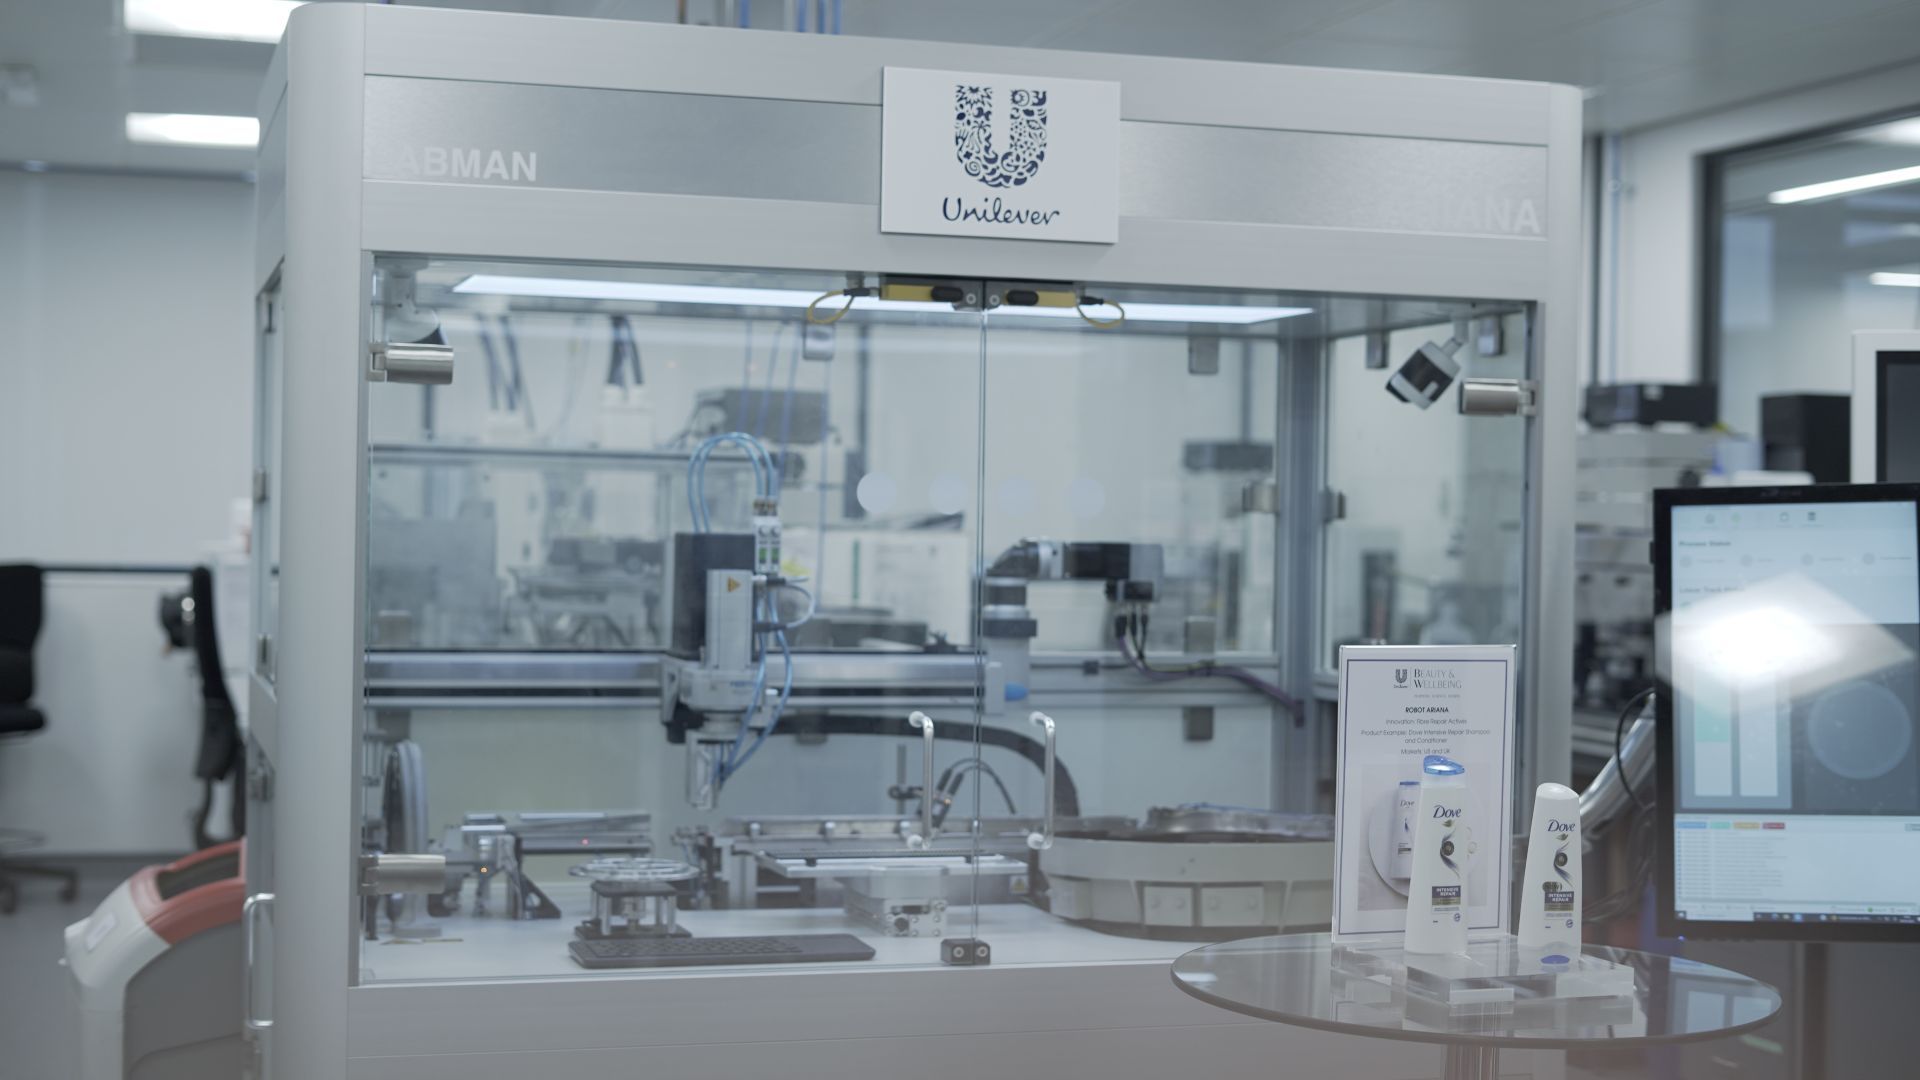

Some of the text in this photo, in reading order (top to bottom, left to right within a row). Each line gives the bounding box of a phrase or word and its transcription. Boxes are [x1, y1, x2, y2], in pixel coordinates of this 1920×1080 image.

[942, 197, 1060, 225] Unilever
[1414, 669, 1455, 678] BEAUTY &
[1414, 679, 1462, 689] WELLBEING
[1448, 729, 1464, 737] Repair
[1433, 805, 1461, 818] Dove
[1548, 819, 1576, 832] Dove
